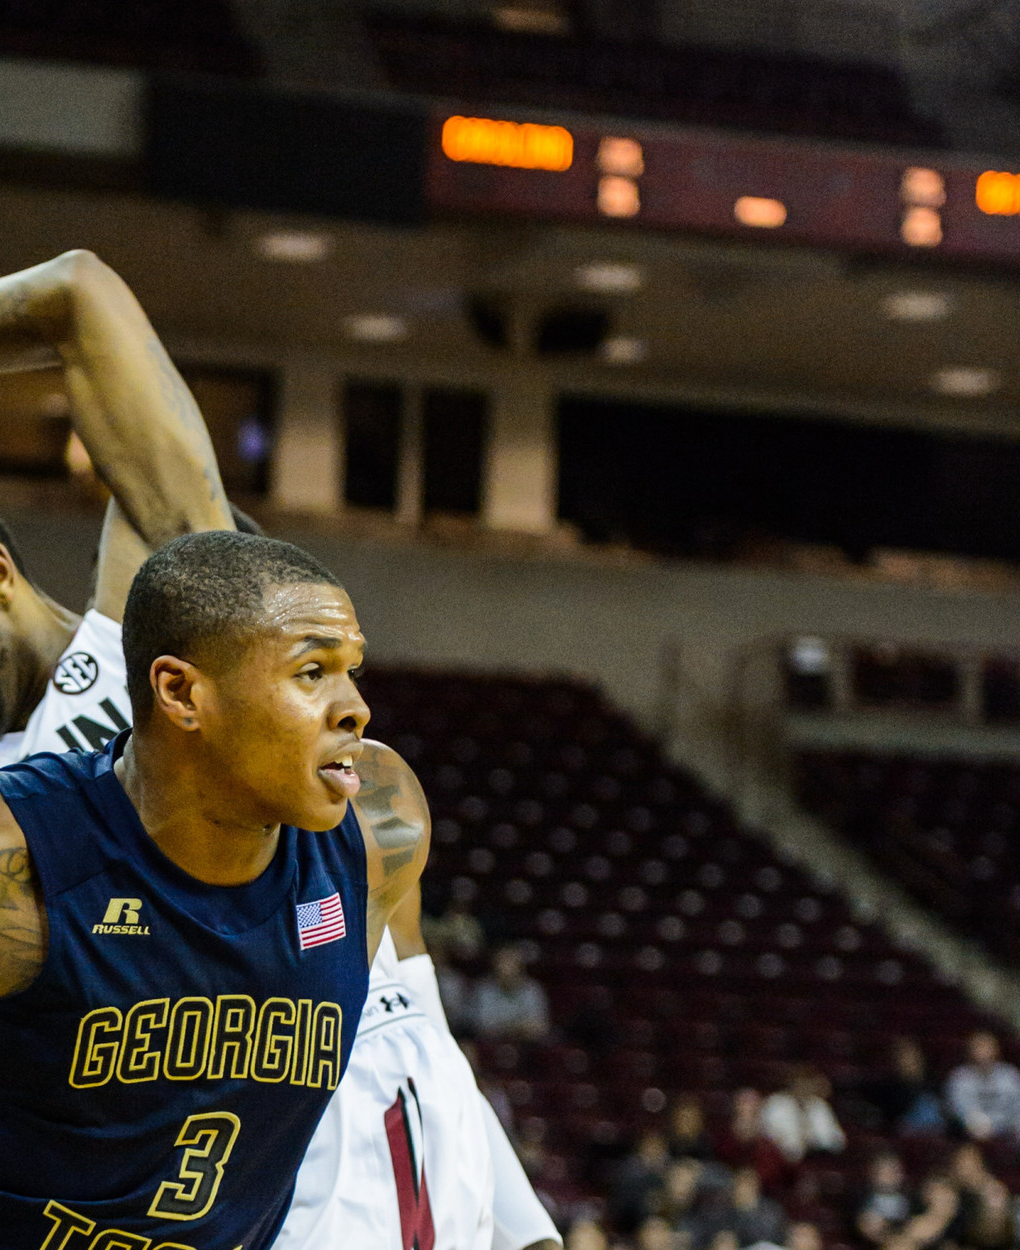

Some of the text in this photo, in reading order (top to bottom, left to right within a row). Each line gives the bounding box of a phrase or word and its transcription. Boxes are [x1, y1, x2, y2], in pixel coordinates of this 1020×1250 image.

[54, 653, 98, 693] SEC
[91, 923, 151, 936] RUSSELL
[68, 994, 343, 1091] GEORGIA
[147, 1111, 241, 1222] 3
